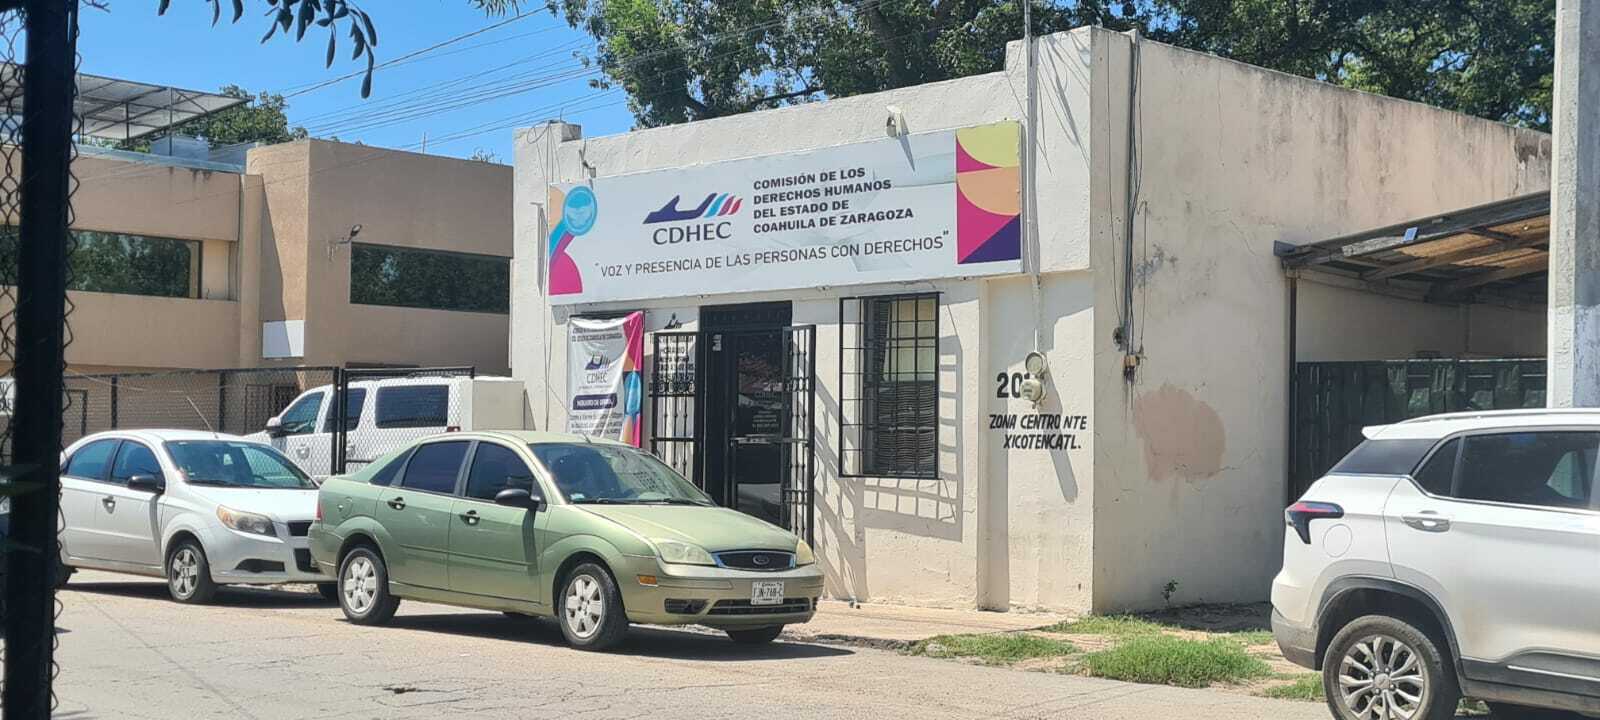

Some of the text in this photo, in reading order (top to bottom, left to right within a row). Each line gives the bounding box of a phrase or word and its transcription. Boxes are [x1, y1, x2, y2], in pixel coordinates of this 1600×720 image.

[753, 168, 865, 190] COMISIÓN DE LOS
[753, 180, 892, 205] DERECHOS HUMANOS
[753, 200, 849, 219] DEL ESTADO DE
[753, 208, 914, 233] COAHUILA DE ZARAGOZA
[652, 222, 732, 245] CDHEC
[625, 264, 632, 275] Y
[635, 258, 702, 275] PRESENCIA
[705, 256, 722, 269] DE
[726, 253, 751, 267] LAS
[754, 246, 827, 264] PERSONAS
[831, 243, 860, 258] CON
[996, 372, 1031, 398] 20
[989, 414, 1087, 430] ZONA CENTRO NTE
[1003, 434, 1081, 450] XICOTENCATL.
